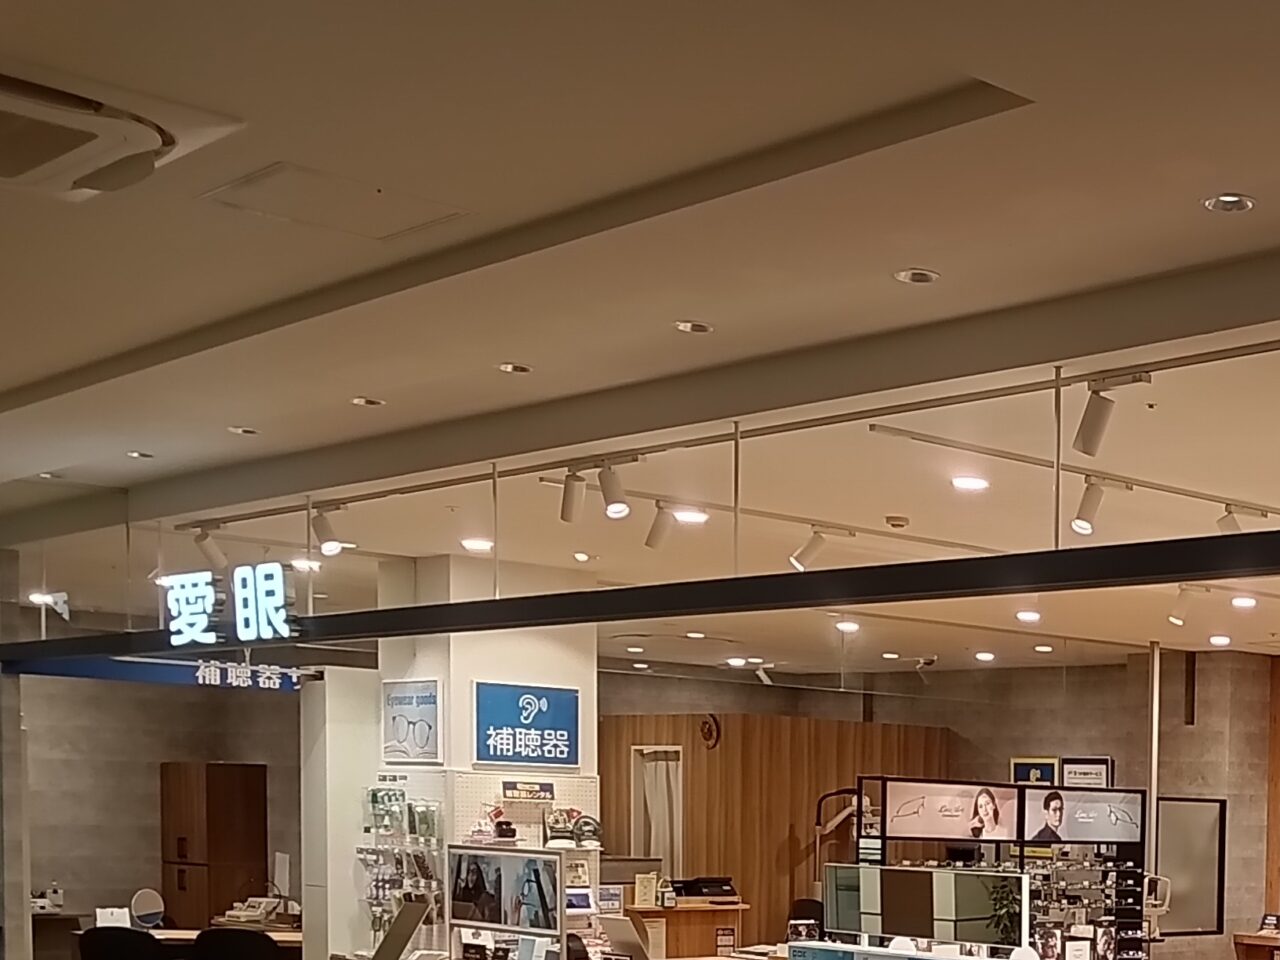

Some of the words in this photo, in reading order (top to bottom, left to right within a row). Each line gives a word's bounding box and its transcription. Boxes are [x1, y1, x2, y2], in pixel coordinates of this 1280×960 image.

[166, 562, 290, 647] 愛眼
[486, 726, 569, 758] 補聴器
